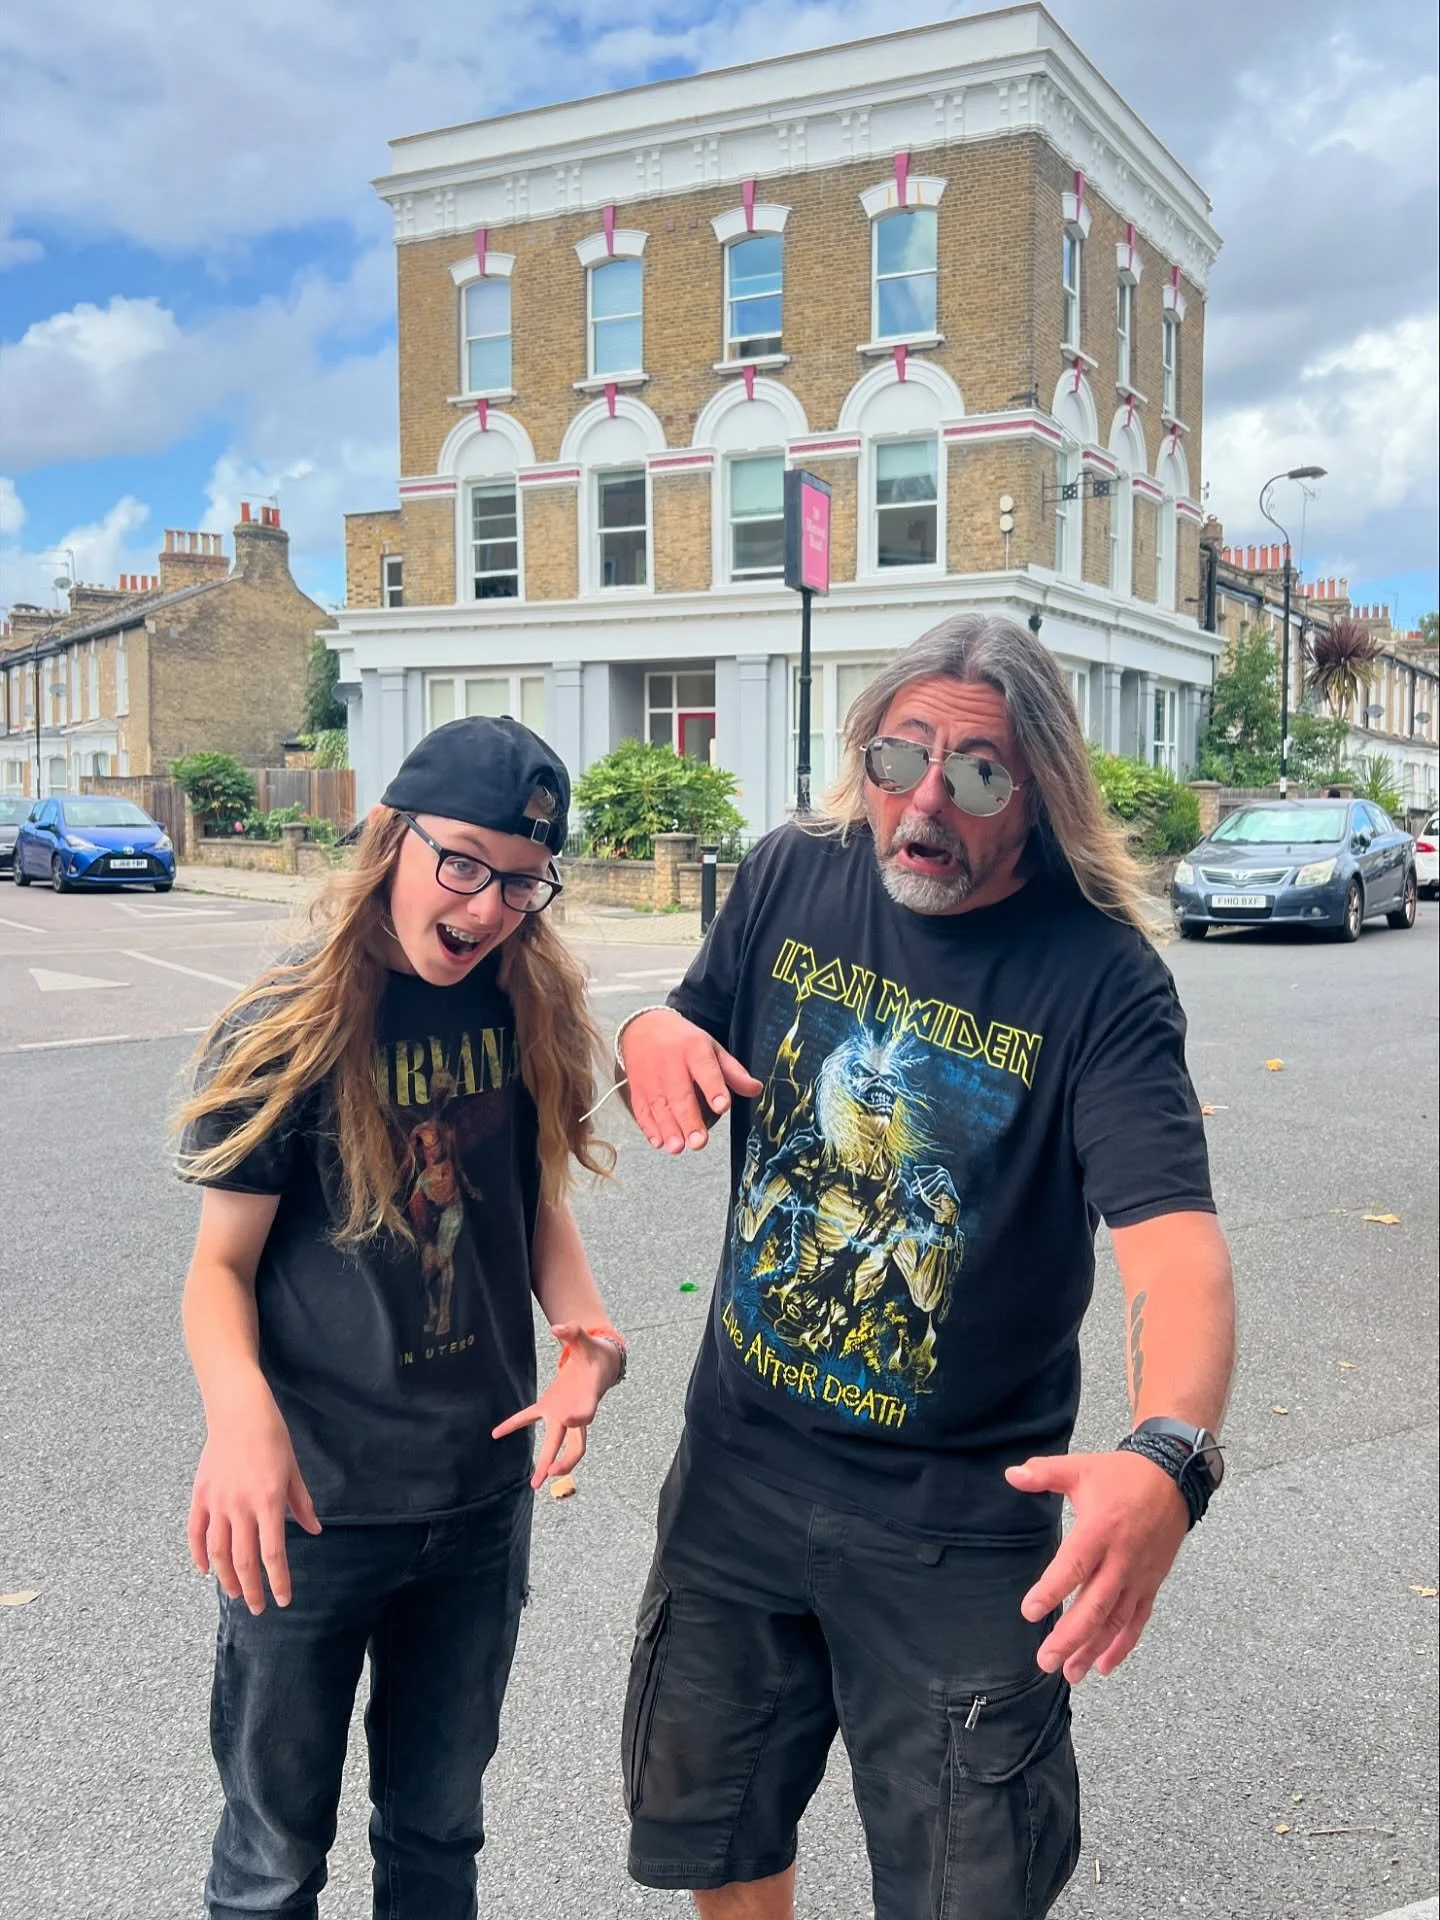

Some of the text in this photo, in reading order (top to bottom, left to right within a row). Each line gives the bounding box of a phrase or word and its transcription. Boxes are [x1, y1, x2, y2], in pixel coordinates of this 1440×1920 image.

[772, 938, 1043, 1090] IRON MAIDEN
[425, 1334, 475, 1359] UTERO
